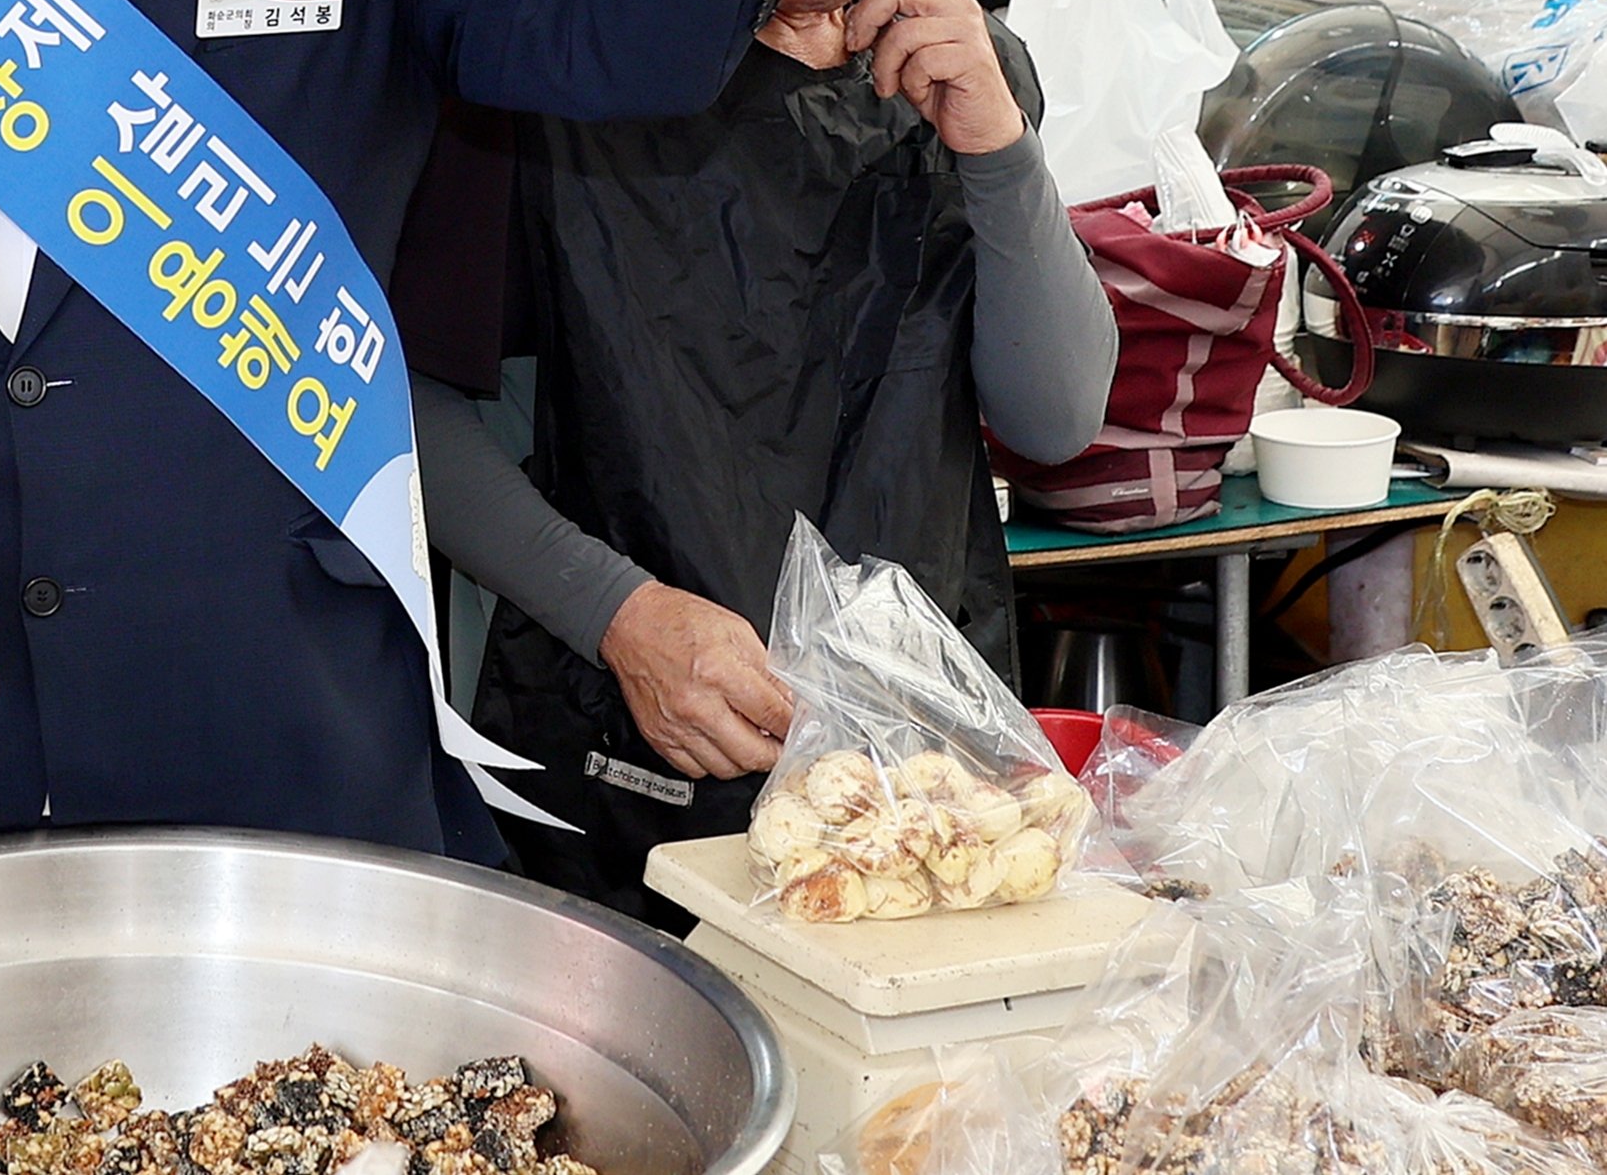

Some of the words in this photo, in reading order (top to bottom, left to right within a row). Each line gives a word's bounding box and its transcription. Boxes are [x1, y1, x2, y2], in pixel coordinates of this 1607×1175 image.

[207, 8, 254, 21] 화순군의회
[66, 155, 358, 471] 이용해요
[106, 68, 325, 305] 살리는
[313, 286, 386, 385] 힘
[593, 759, 615, 776] Bt
[614, 768, 641, 785] choice
[652, 781, 687, 799] baristas
